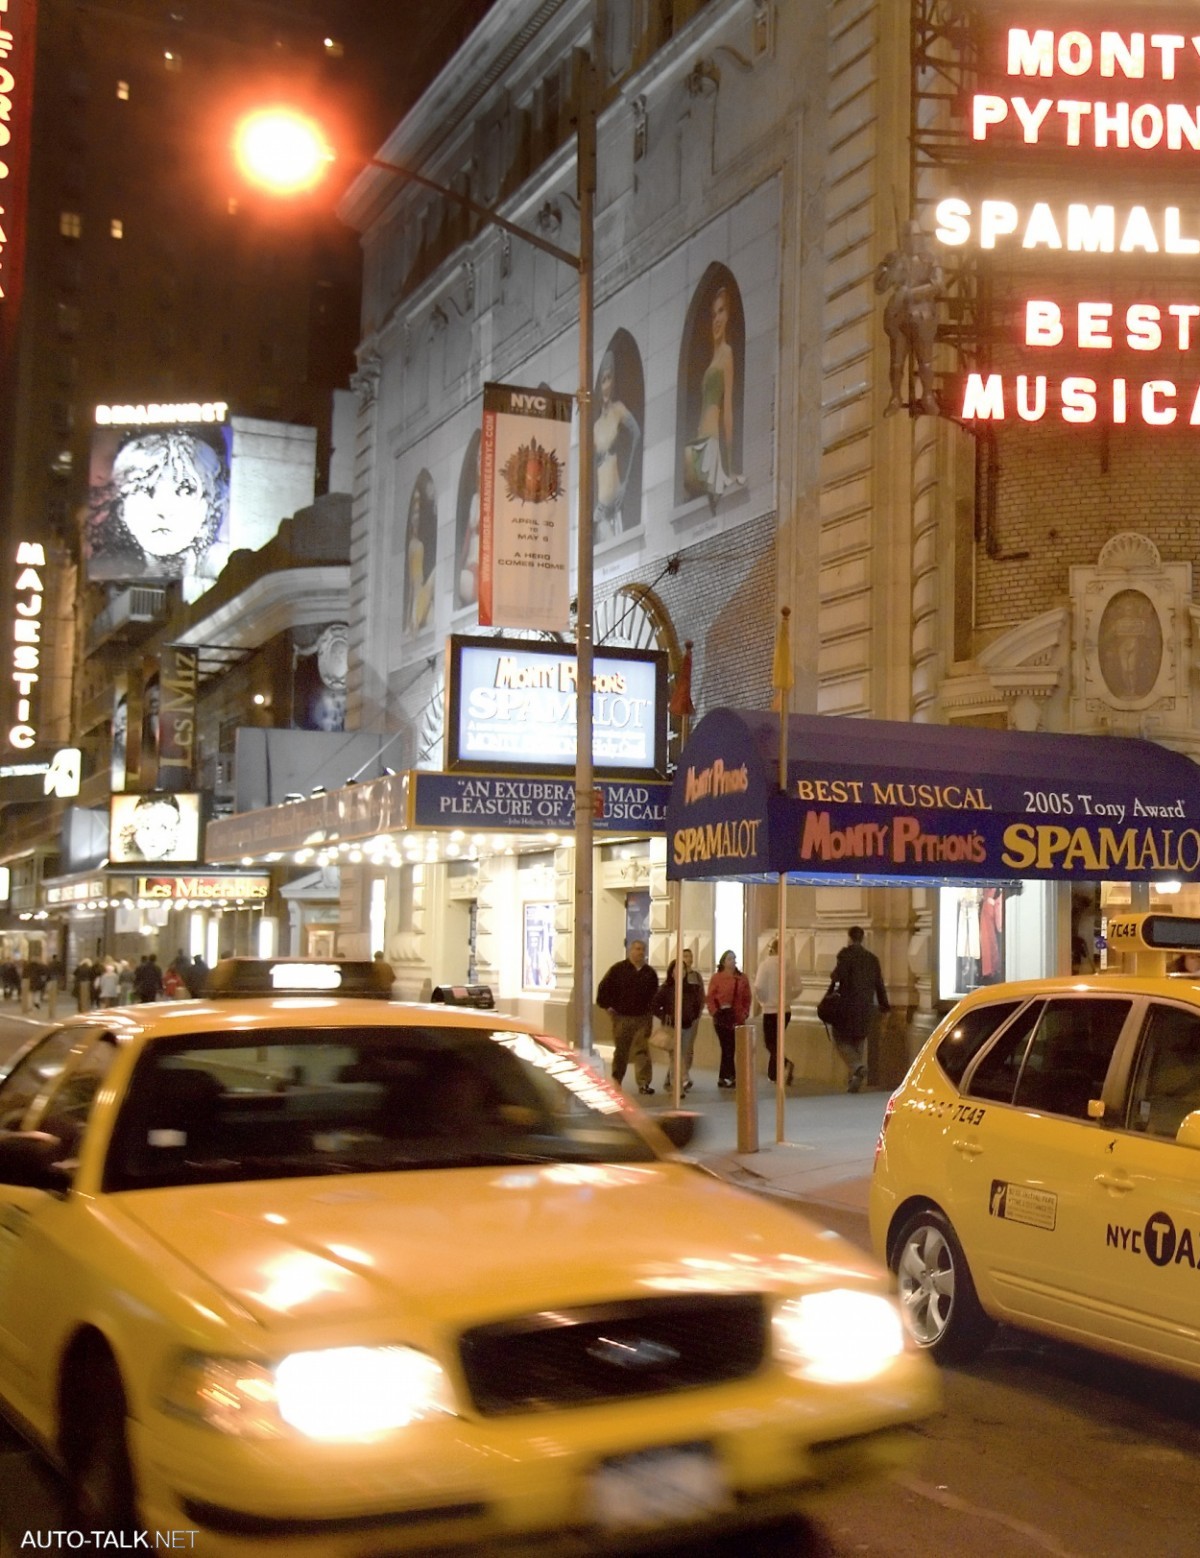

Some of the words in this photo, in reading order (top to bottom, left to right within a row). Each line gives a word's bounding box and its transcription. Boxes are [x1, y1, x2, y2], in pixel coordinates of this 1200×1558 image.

[1025, 300, 1200, 351] BEST
[510, 393, 547, 411] NYC
[511, 517, 539, 526] APRIL
[517, 533, 539, 541] MAY
[497, 559, 535, 568] COMES
[537, 562, 565, 570] HOME
[524, 552, 551, 561] HERO
[8, 541, 45, 750] MAJESTIC
[494, 655, 555, 690] MONTY
[467, 686, 648, 729] SPAMLOT
[608, 786, 649, 805] MAD
[797, 779, 864, 804] BEST
[871, 782, 993, 811] MUSICAL
[440, 796, 533, 816] PLEASURE
[537, 801, 565, 817] OF
[1023, 790, 1075, 816] 2005
[1077, 794, 1127, 825] Tony
[1133, 797, 1186, 819] Award
[673, 819, 759, 866] SPAMALOT
[800, 810, 889, 861] MONTY
[893, 815, 987, 864] PYTHON'S
[138, 876, 173, 898] Les
[1110, 923, 1137, 938] 7C43
[952, 1104, 986, 1126] 7C43
[1106, 1222, 1142, 1254] NYC
